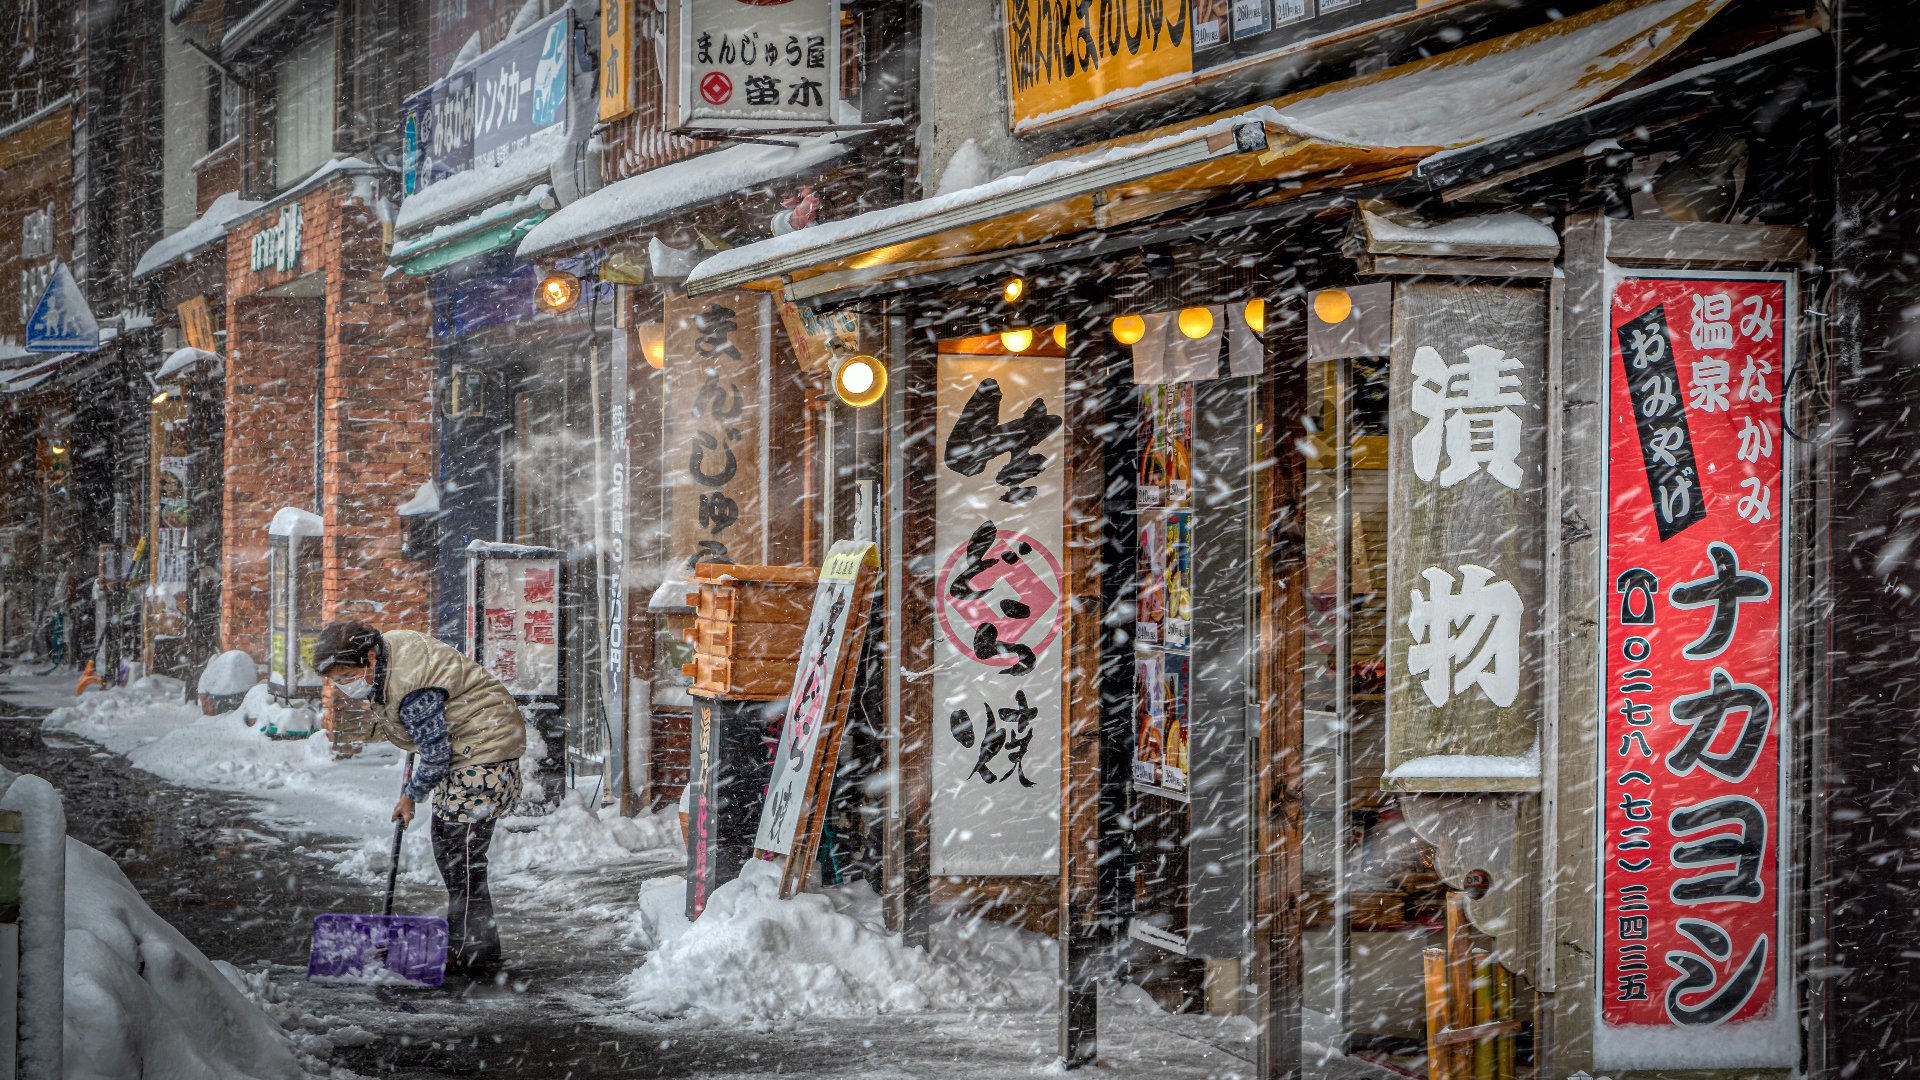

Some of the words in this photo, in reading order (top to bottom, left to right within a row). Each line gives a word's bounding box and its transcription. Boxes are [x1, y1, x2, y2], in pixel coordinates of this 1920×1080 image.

[434, 85, 475, 157] みなかみ
[475, 61, 531, 140] レンタカー
[697, 31, 825, 69] まんじゅう屋
[745, 74, 824, 108] 笛木
[1631, 322, 1695, 524] おみやげ
[1689, 292, 1734, 413] 温泉
[1737, 295, 1774, 524] みなかみ
[944, 377, 1063, 788] 生どら焼
[1408, 344, 1527, 708] 漬物
[1664, 542, 1773, 1028] ナカヨシ
